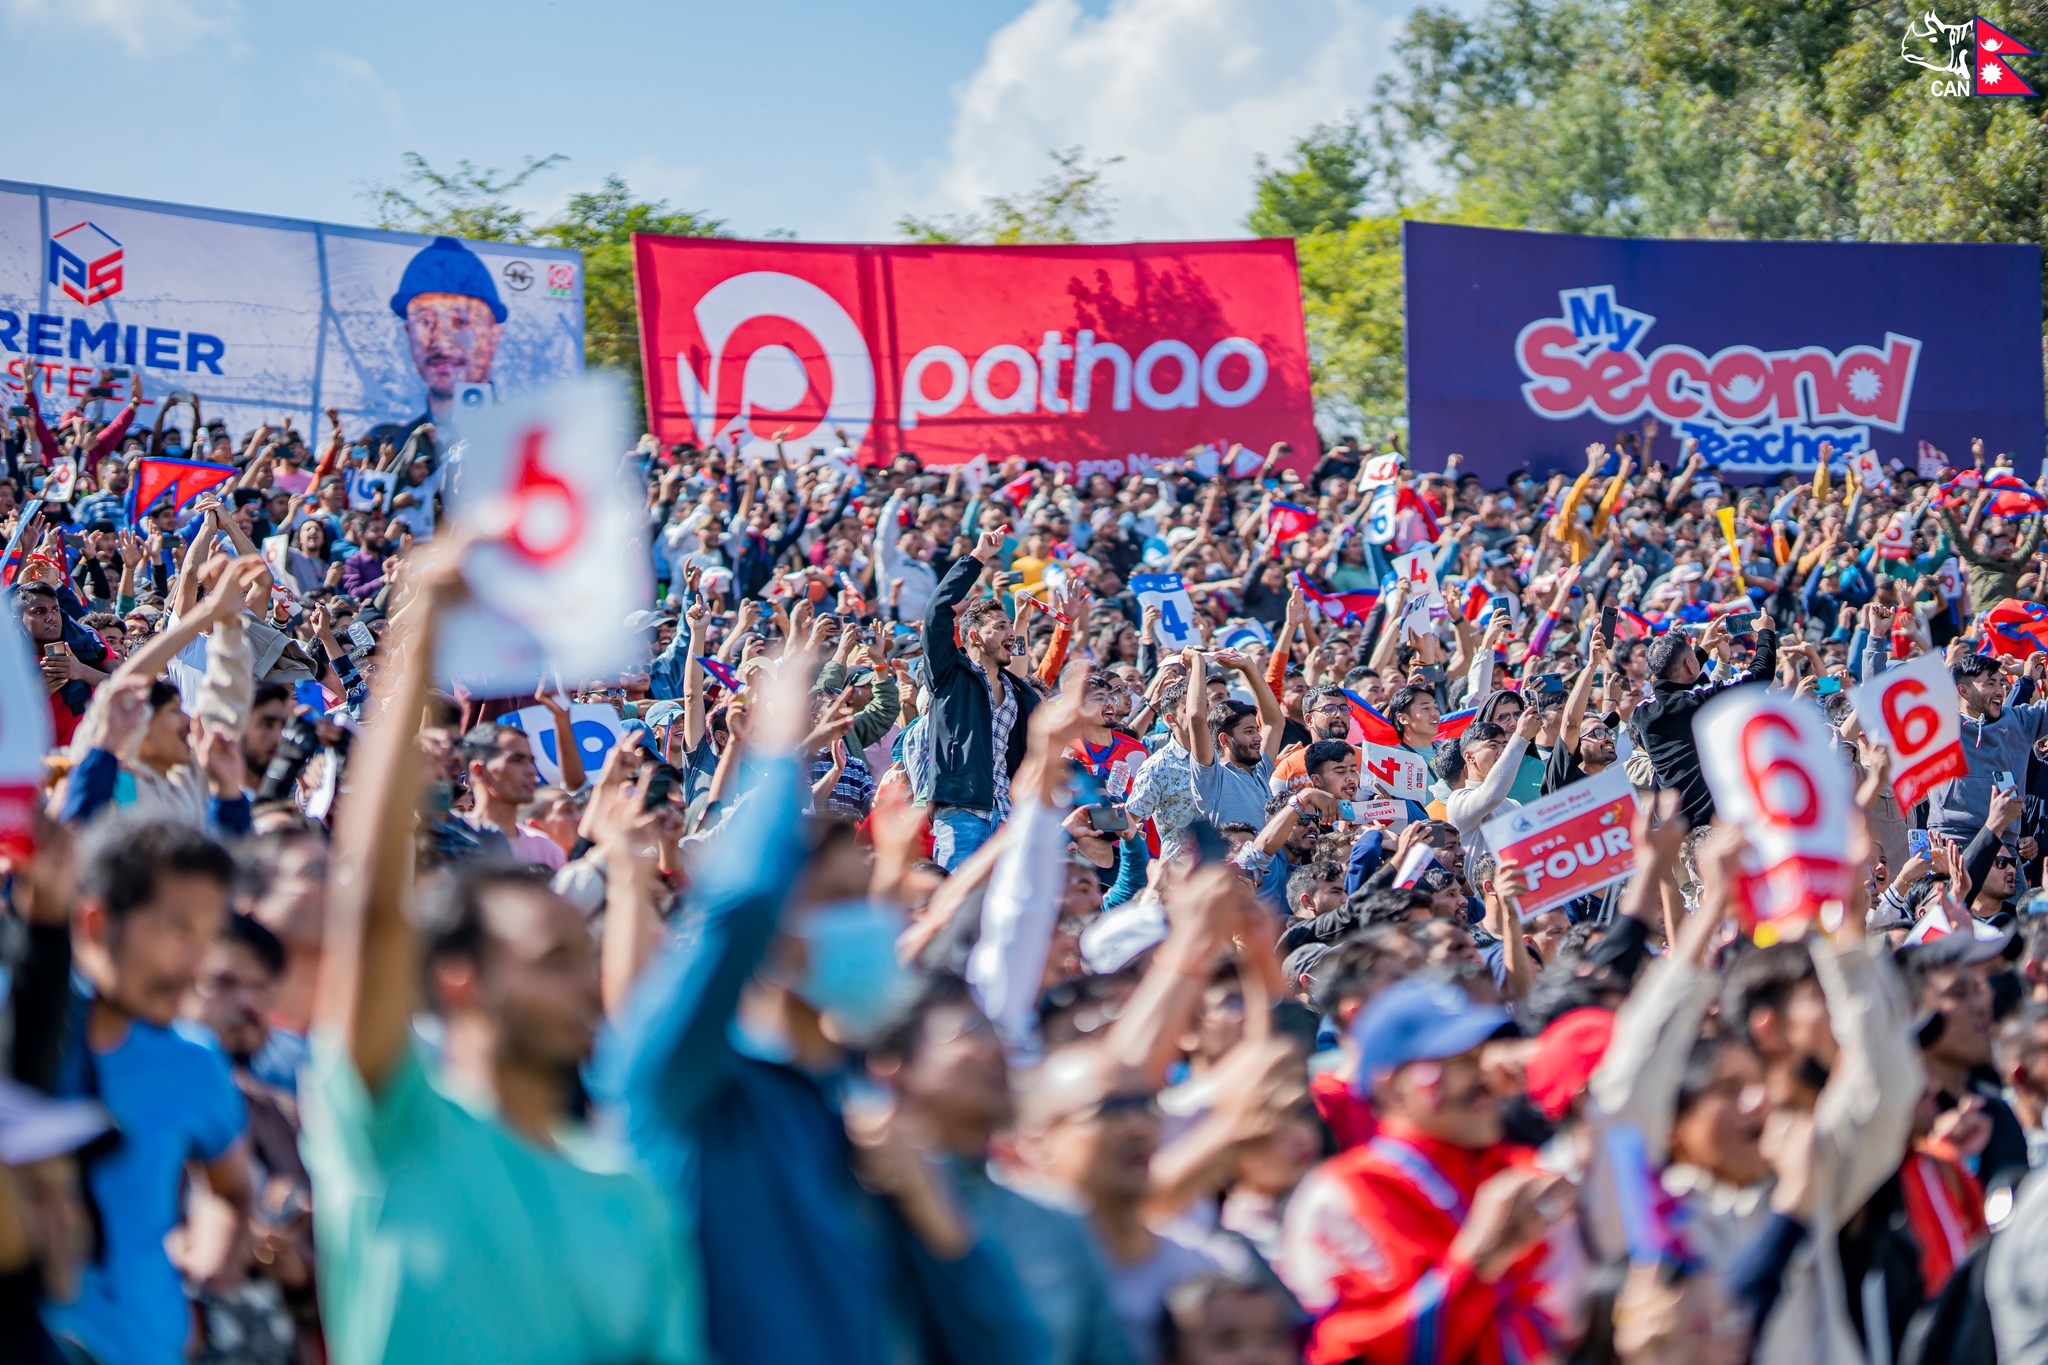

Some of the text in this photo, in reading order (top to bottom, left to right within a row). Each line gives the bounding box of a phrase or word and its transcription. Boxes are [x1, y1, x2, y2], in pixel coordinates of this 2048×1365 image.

[1566, 288, 1648, 352] My
[899, 328, 1269, 430] pathao
[1521, 321, 1918, 427] Second
[1372, 504, 1389, 535] 6
[1410, 557, 1428, 584] 4
[1161, 599, 1190, 641] 4
[1882, 677, 1940, 756] 6
[1367, 756, 1401, 787] 4
[1742, 713, 1819, 829] 6
[1522, 825, 1634, 892] FOUR
